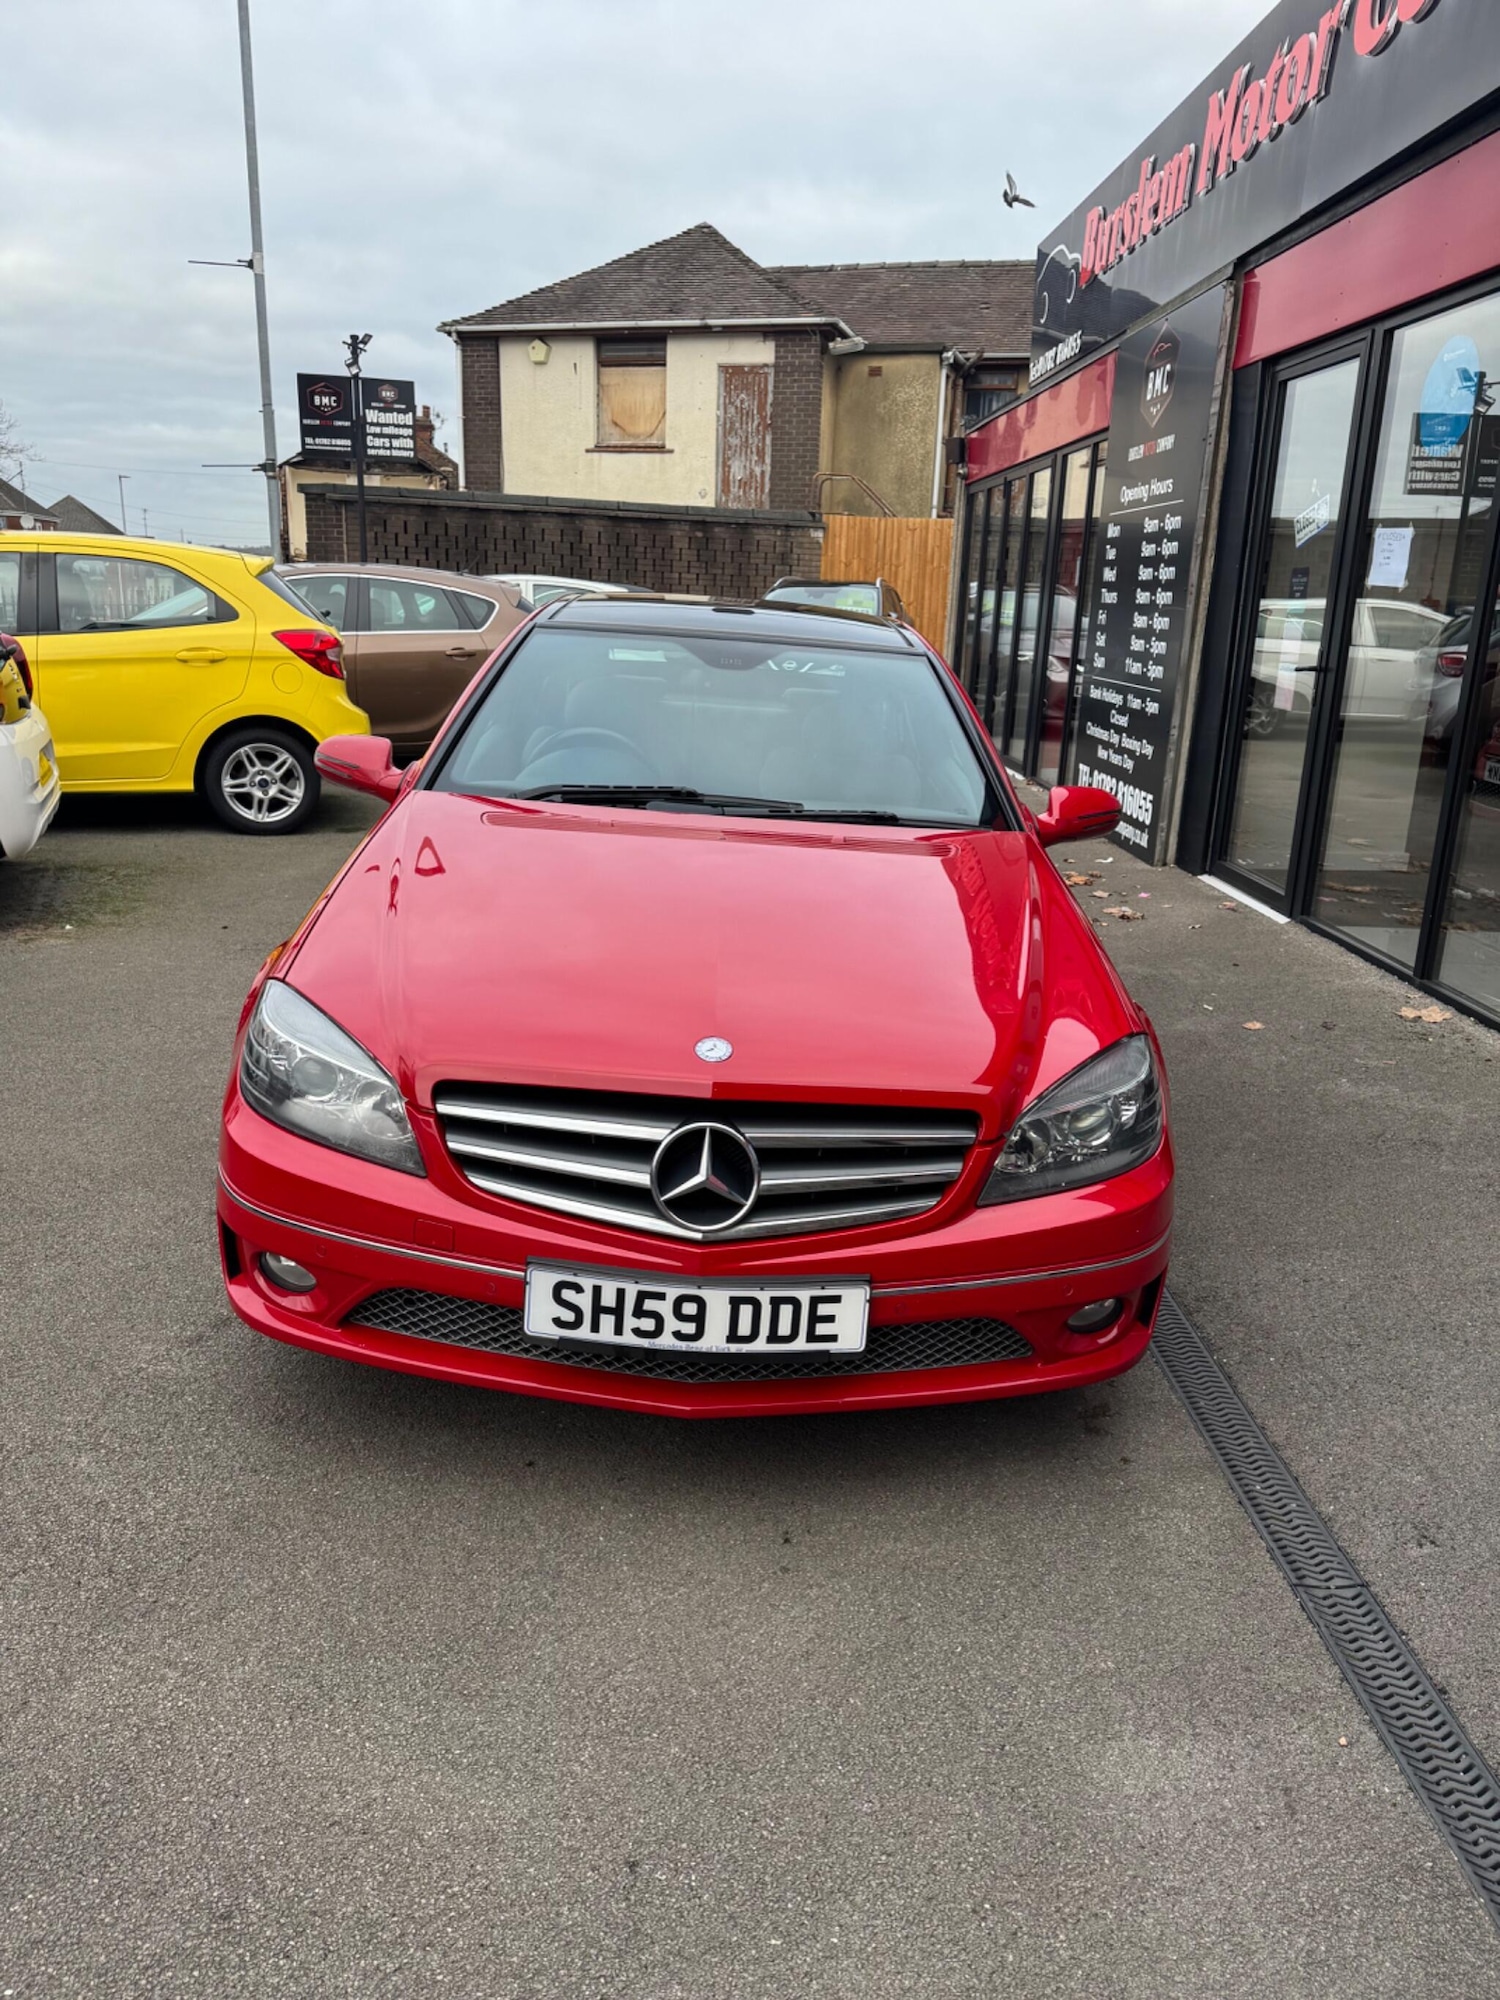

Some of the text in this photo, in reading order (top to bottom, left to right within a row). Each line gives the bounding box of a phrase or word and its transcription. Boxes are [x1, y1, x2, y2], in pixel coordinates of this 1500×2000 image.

[1079, 0, 1348, 289] Burslem Motor
[1146, 363, 1172, 401] BMC
[314, 395, 338, 407] BMC
[365, 409, 413, 426] Wanted
[366, 424, 413, 437] Low mileage
[366, 435, 414, 449] Cars with
[367, 448, 414, 459] service history
[1120, 477, 1174, 506] Opening Hours
[1107, 522, 1121, 538] Mon
[1143, 516, 1159, 533] 9am
[1164, 513, 1181, 534] 6pm
[1105, 544, 1117, 560] Tue
[1140, 541, 1156, 557] 9am
[1161, 538, 1179, 559] 6pm
[1102, 566, 1117, 582] Wed
[1138, 564, 1153, 581] 9am
[1158, 562, 1176, 584] 6pm
[1101, 588, 1118, 604] Thurs
[1135, 588, 1150, 604] 9am
[1156, 587, 1173, 609] 6pm
[1097, 609, 1107, 625] Fri
[1132, 611, 1148, 628] 9am
[1153, 612, 1170, 634] 6pm
[1095, 631, 1106, 647] Sat
[1130, 634, 1145, 652] 9am
[1149, 636, 1167, 658] 5pm
[1093, 652, 1105, 669] Sun
[1125, 657, 1142, 675] 11am
[1146, 660, 1164, 681] 5pm
[1090, 684, 1102, 701] Bank
[1102, 687, 1124, 708] Holidays
[1127, 693, 1142, 710] 11am
[1145, 697, 1160, 716] 5pm
[1110, 709, 1129, 728] Closed
[1086, 721, 1154, 760] Christmas Day Boxing Day
[1097, 744, 1109, 760] New
[1122, 754, 1135, 774] Day
[1117, 780, 1154, 826] 816055
[550, 1279, 843, 1345] SH59 DDE
